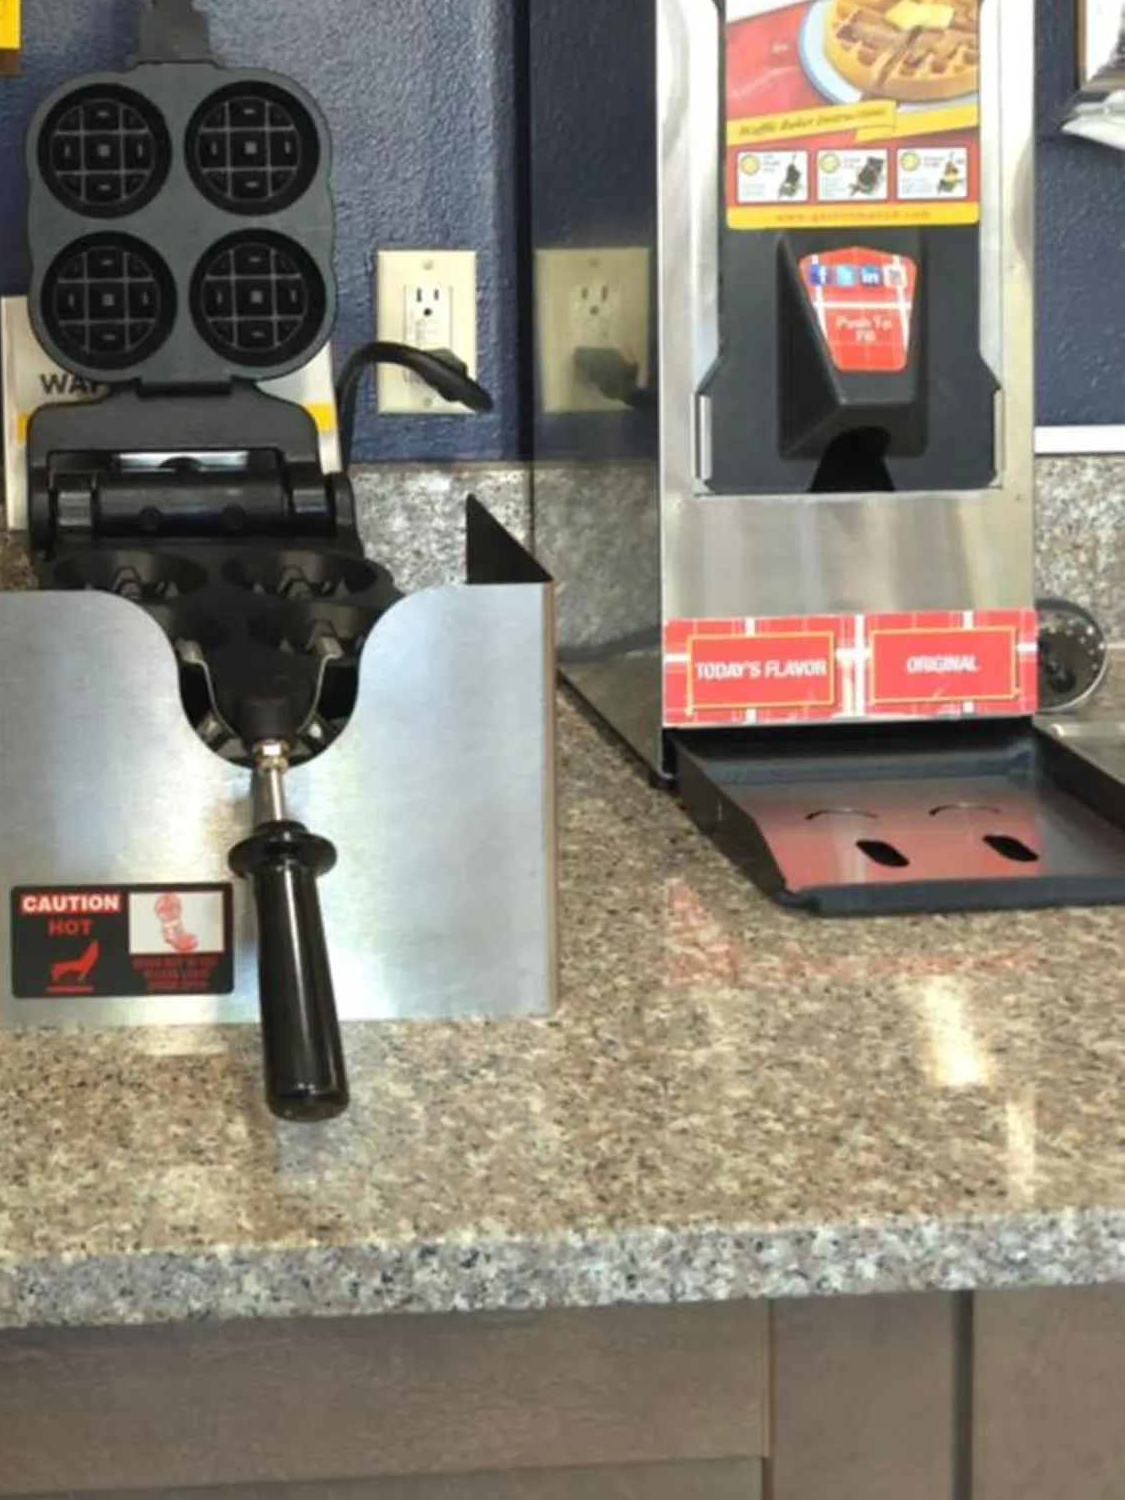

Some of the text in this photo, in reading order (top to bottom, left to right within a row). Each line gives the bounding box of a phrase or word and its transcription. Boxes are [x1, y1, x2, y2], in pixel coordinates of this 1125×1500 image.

[696, 658, 827, 680] TODAY'S FLAVOR
[906, 655, 980, 674] ORIGINAL
[21, 894, 121, 913] CAUTION
[47, 918, 94, 936] HOT
